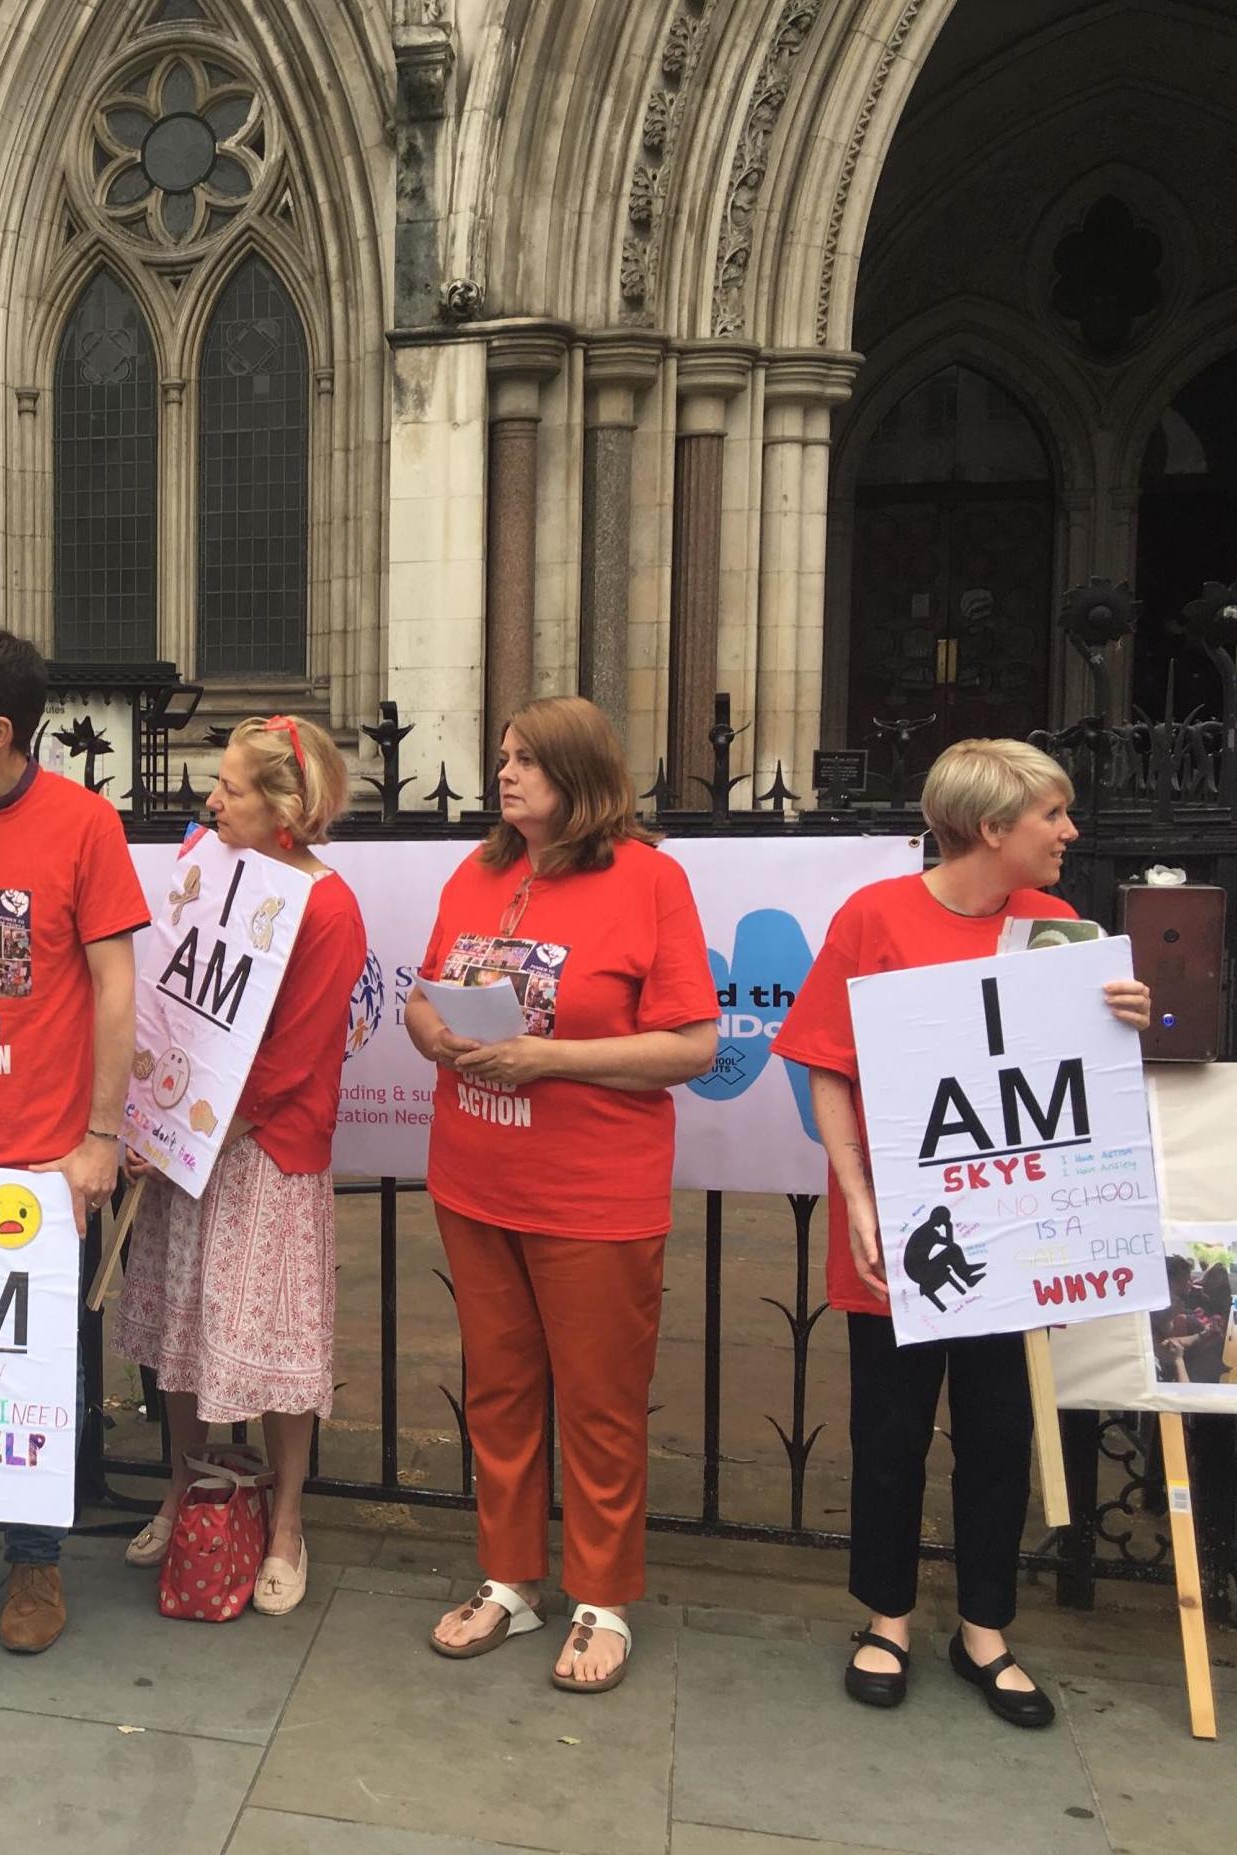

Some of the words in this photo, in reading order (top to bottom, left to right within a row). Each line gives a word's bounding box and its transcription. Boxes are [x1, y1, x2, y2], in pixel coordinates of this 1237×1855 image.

[220, 859, 246, 928] I
[159, 926, 254, 1025] AM
[981, 977, 1005, 1056] I
[393, 1085, 405, 1101] &
[457, 1083, 531, 1127] ACTION
[919, 1058, 1091, 1159] AM
[943, 1152, 1046, 1193] SKYE
[997, 1194, 1038, 1217] NO
[1051, 1181, 1148, 1211] SCHOOL
[1036, 1219, 1057, 1240] IS
[1066, 1216, 1083, 1236] A
[1091, 1233, 1155, 1261] PLACE
[1032, 1267, 1134, 1307] WHY?
[12, 1403, 68, 1428] NEED
